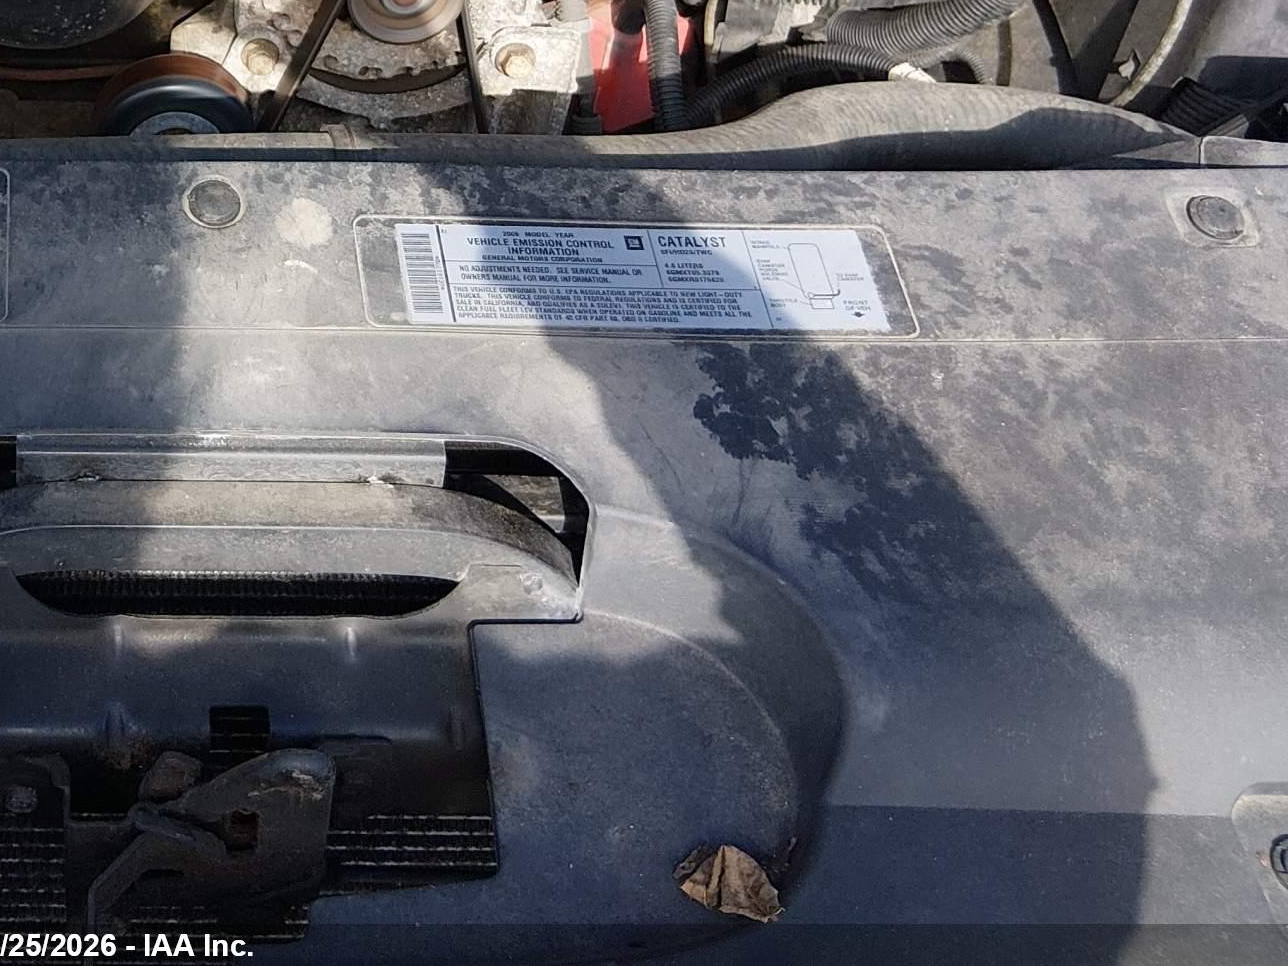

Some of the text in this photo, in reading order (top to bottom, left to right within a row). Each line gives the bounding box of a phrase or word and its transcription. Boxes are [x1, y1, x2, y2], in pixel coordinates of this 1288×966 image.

[467, 238, 614, 248] VEHICLE EMISSION CONTROL
[658, 236, 726, 248] CATALYST
[508, 247, 579, 255] INFORMATION
